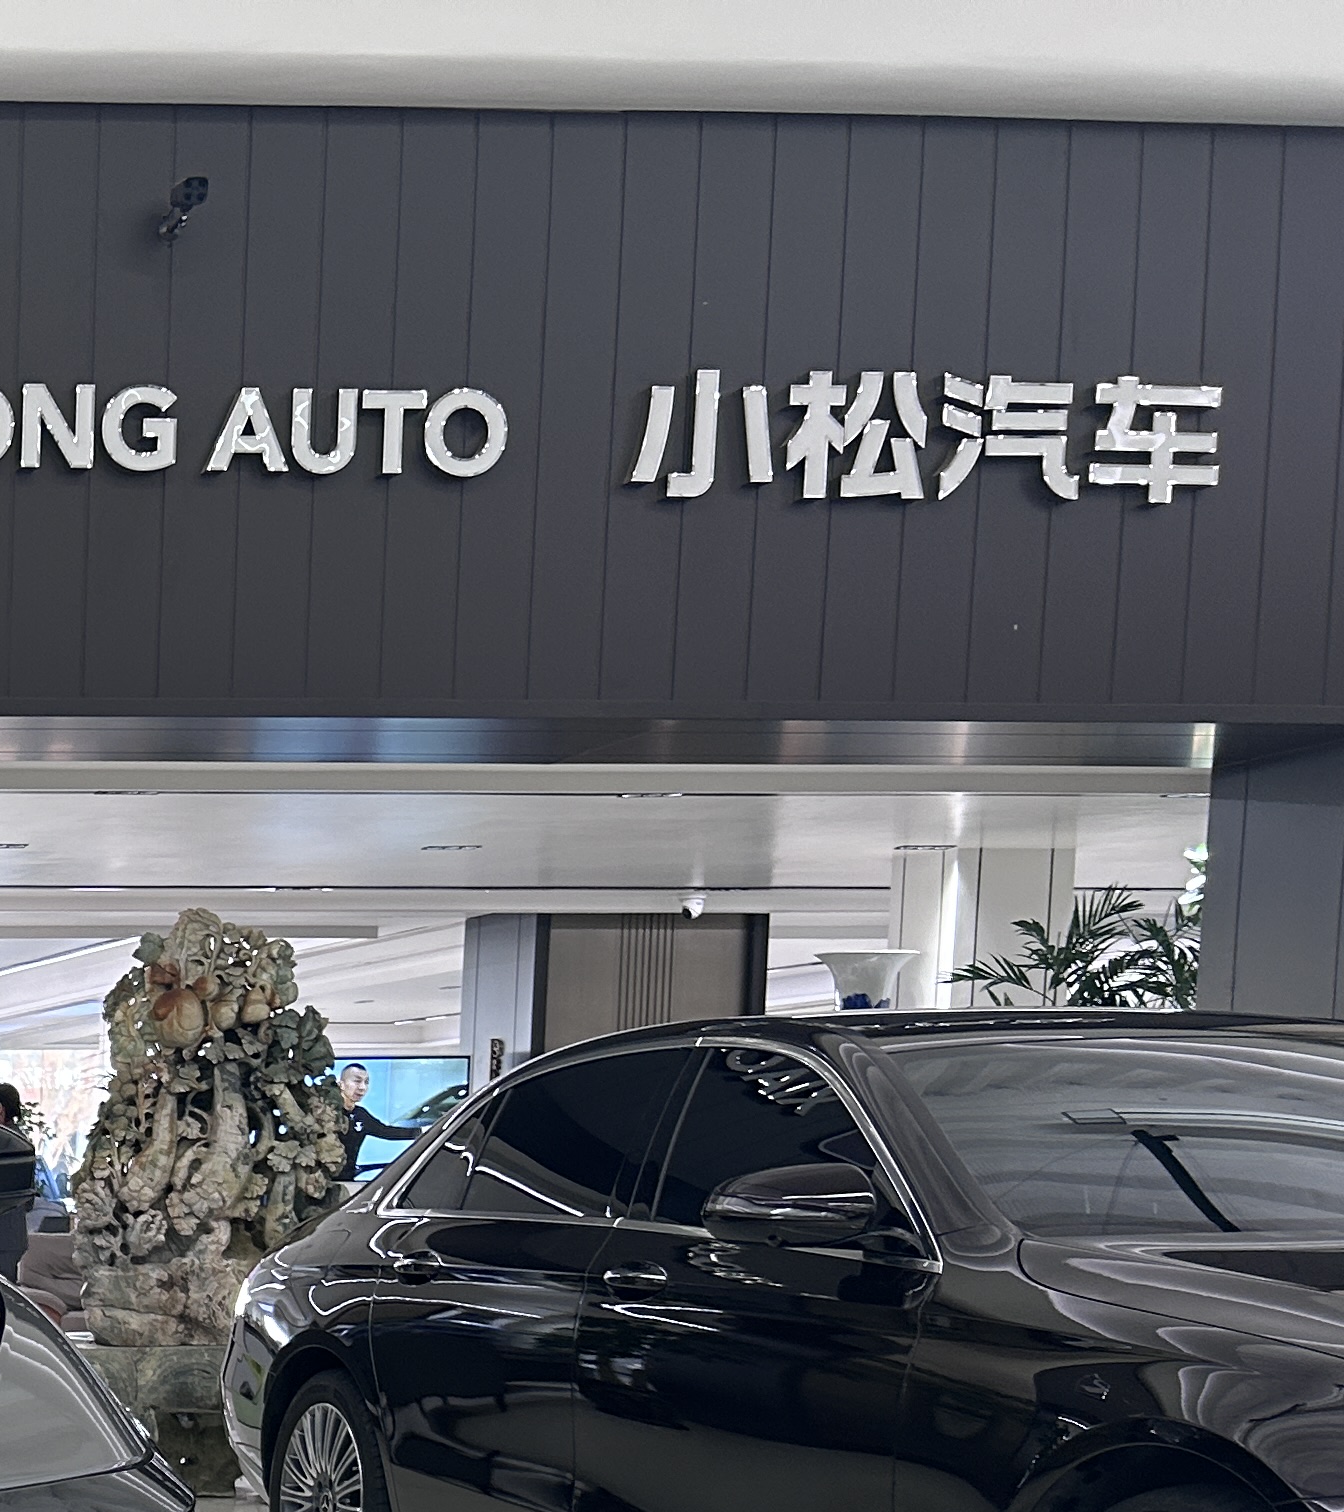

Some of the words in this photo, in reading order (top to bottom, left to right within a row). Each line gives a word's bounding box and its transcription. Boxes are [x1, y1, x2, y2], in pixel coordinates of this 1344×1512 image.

[201, 385, 509, 478] AUTO
[627, 369, 1223, 503] 小松汽车
